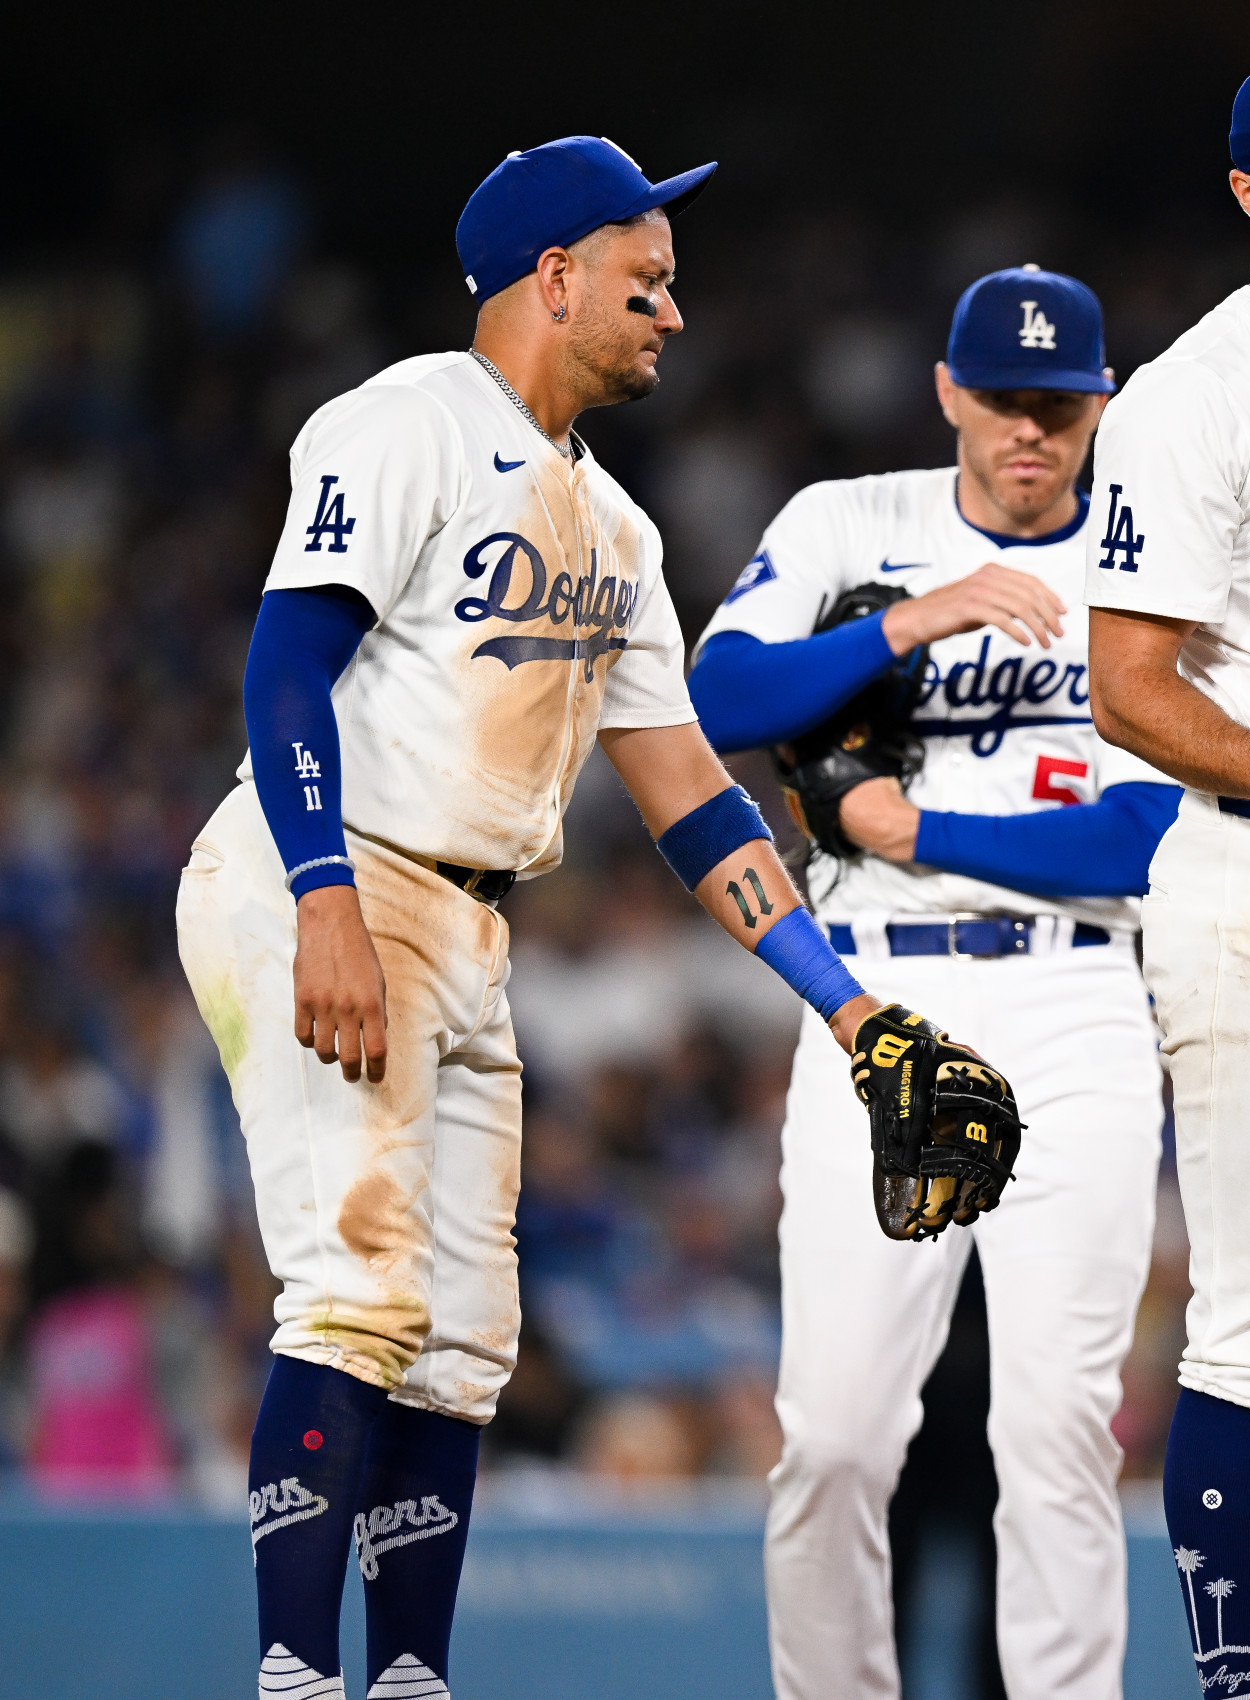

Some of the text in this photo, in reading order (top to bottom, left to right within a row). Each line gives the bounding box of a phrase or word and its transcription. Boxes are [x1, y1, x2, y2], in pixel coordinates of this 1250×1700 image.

[1018, 300, 1057, 350] LA
[304, 474, 357, 553] LA
[1098, 483, 1145, 573] LA
[914, 634, 1090, 758] odger
[291, 742, 322, 779] LA
[1031, 754, 1089, 807] 5
[303, 785, 323, 811] 11
[900, 1060, 914, 1106] MIGGYRO
